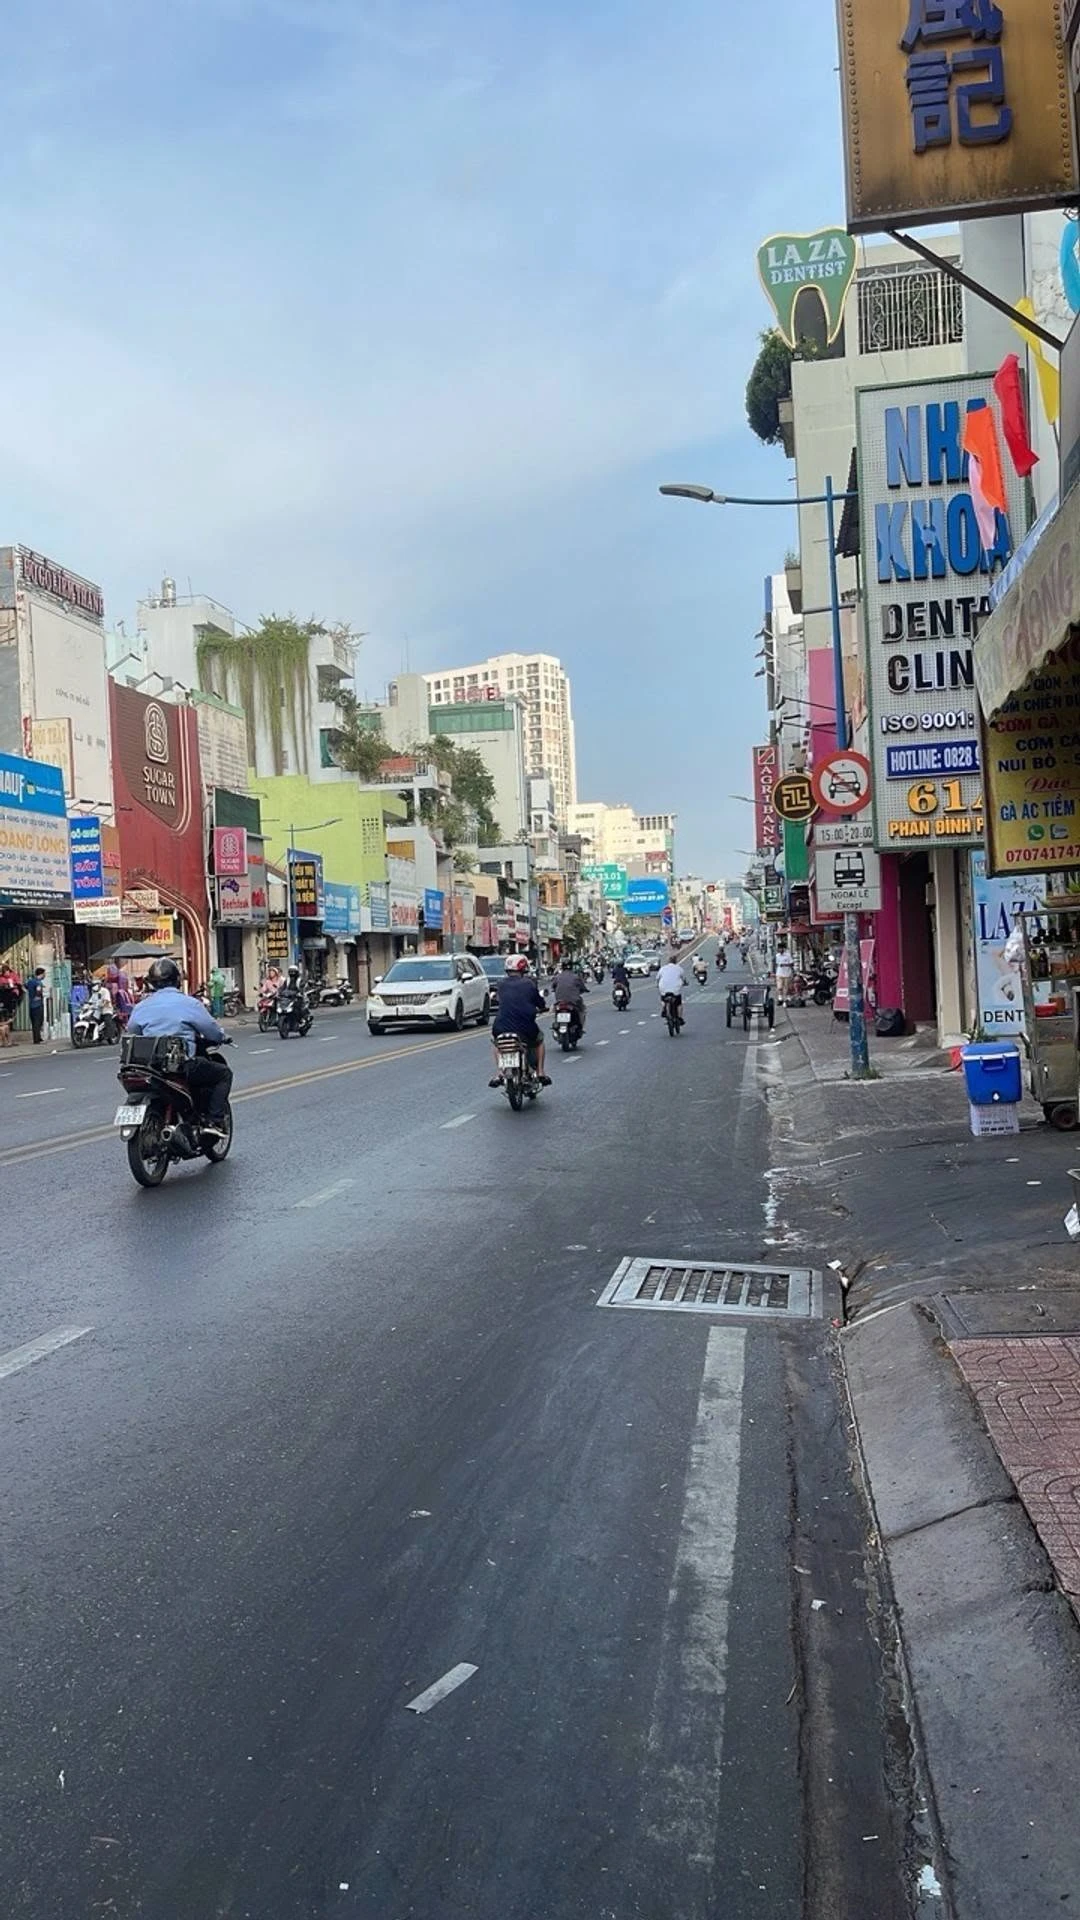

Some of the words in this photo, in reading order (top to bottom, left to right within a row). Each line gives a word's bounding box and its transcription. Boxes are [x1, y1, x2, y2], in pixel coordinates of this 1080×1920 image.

[767, 244, 803, 268] LA
[808, 238, 847, 262] ZA
[771, 261, 845, 284] DENTIST
[881, 714, 918, 734] ISO
[920, 710, 975, 730] 9001:
[890, 748, 941, 772] HOTLINE:
[944, 746, 973, 768] 0828
[998, 758, 1026, 773] NUI
[143, 766, 175, 790] SUGAR
[144, 785, 175, 807] TOWN
[760, 766, 774, 845] AGRIBANK
[888, 819, 930, 838] PHAN
[837, 902, 862, 911] Except
[984, 1010, 1024, 1022] DENT
